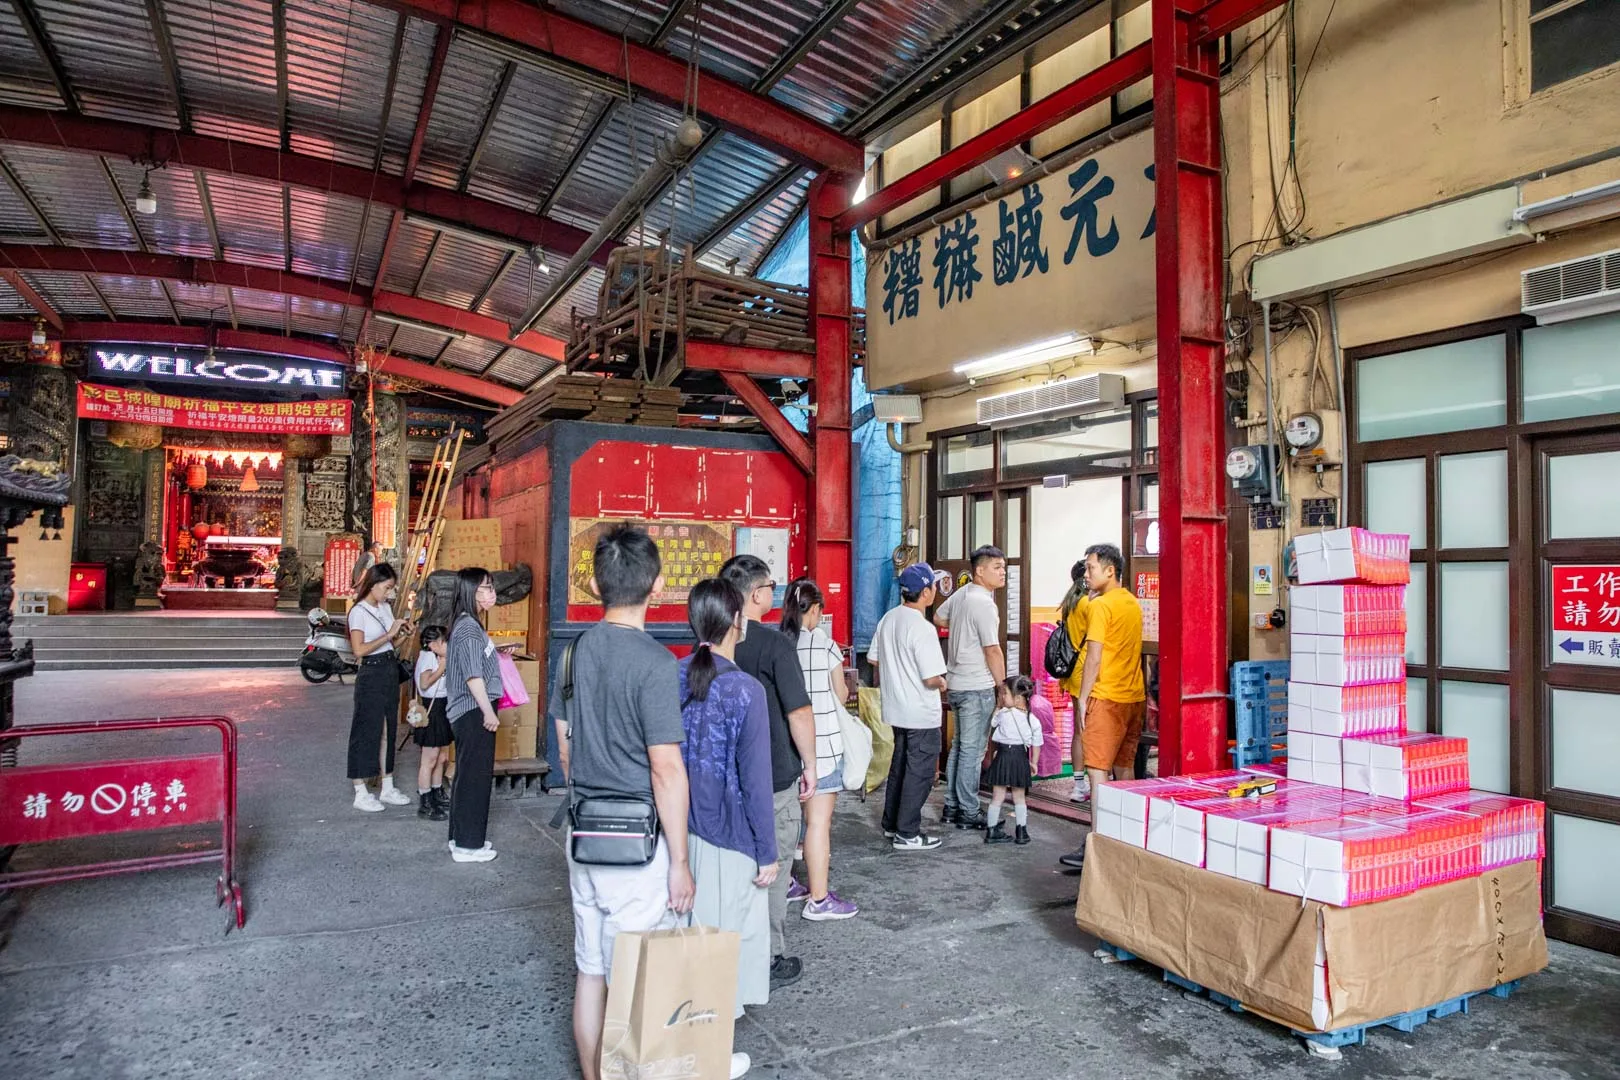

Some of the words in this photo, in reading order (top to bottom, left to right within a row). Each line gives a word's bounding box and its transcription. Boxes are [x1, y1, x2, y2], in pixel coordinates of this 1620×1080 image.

[96, 350, 343, 388] WELCOME
[1562, 600, 1620, 627] 請勿
[22, 790, 85, 819] 請勿
[130, 779, 188, 808] 停車
